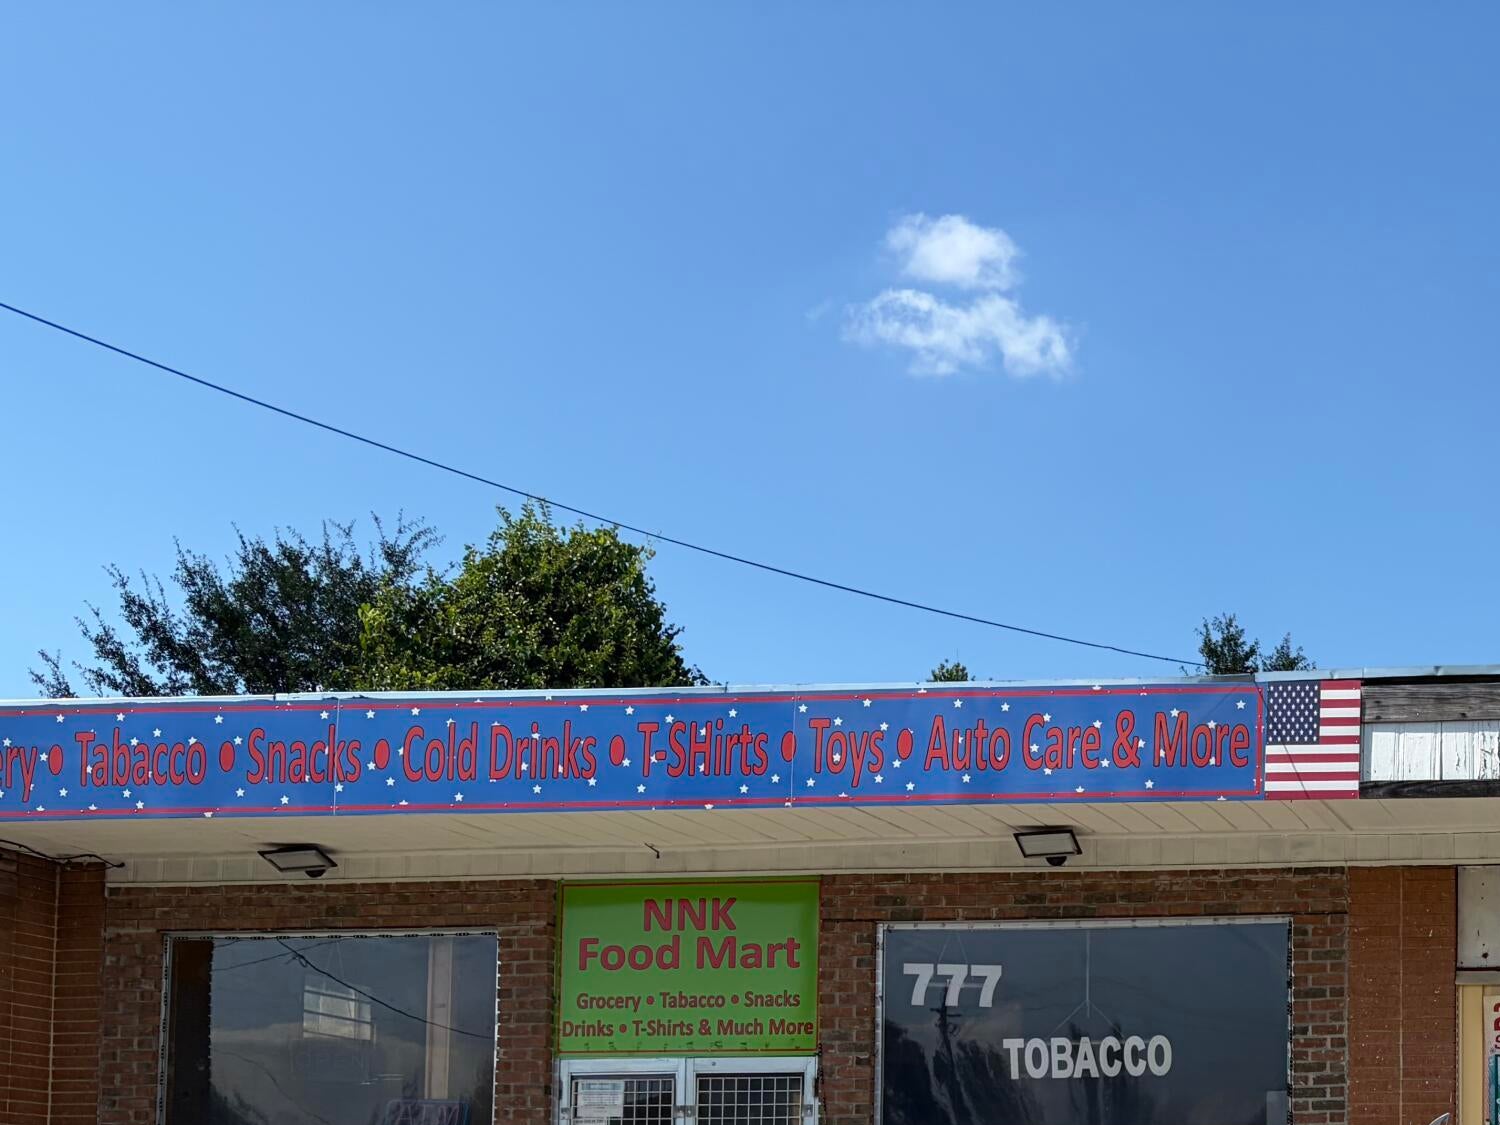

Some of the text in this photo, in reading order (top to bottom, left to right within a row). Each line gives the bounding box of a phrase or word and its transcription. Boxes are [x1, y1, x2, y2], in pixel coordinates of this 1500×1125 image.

[0, 742, 37, 803] ry
[75, 727, 206, 787] Tabacco
[246, 724, 361, 784] Snacks
[402, 721, 478, 782] Cold
[489, 720, 597, 780] Drinks
[809, 718, 884, 788] Toys
[924, 714, 1011, 771] Auto
[1022, 713, 1101, 770] Care
[1113, 709, 1141, 769] &
[1153, 711, 1250, 768] More
[643, 897, 737, 932] NNK
[578, 935, 801, 971] Food Mart
[576, 989, 800, 1013] Grocery Tabacco Snacks
[903, 963, 1002, 1008] 777
[562, 1018, 814, 1037] Drinks T-Shirts & Much More
[1003, 1034, 1173, 1080] TOBACCO
